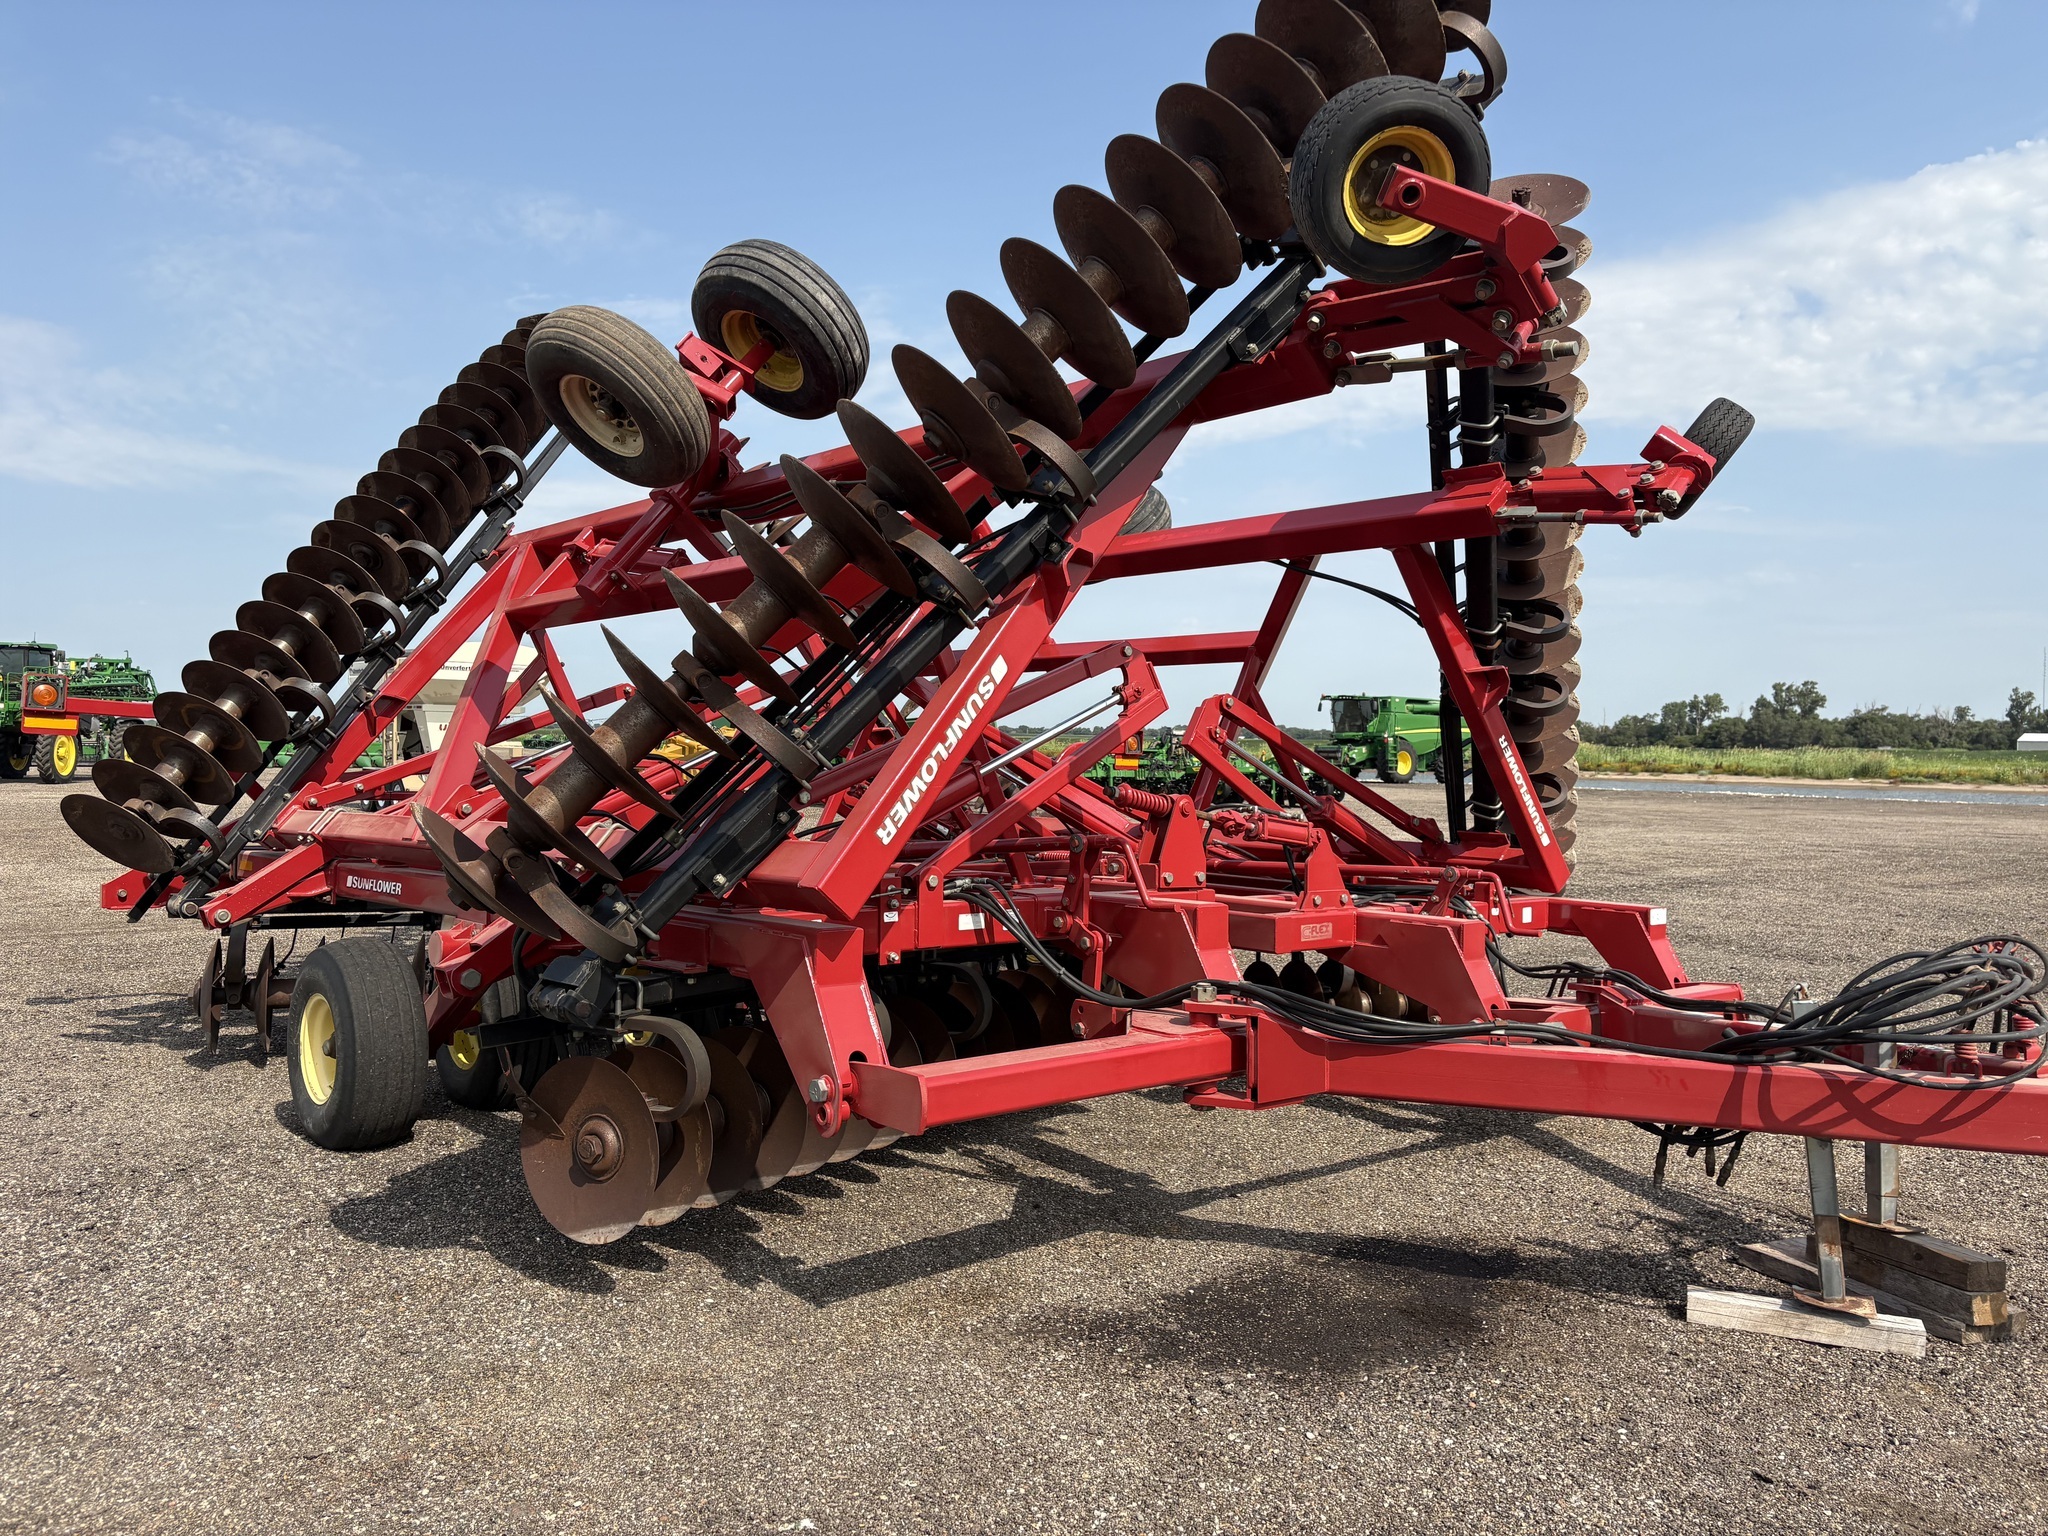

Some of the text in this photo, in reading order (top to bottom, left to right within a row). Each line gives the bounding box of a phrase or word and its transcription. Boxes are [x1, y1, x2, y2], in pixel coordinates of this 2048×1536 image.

[874, 674, 995, 846] SUNFLOWER
[1499, 734, 1546, 836] SUNFLOWER
[352, 876, 402, 895] SUNFLOWER
